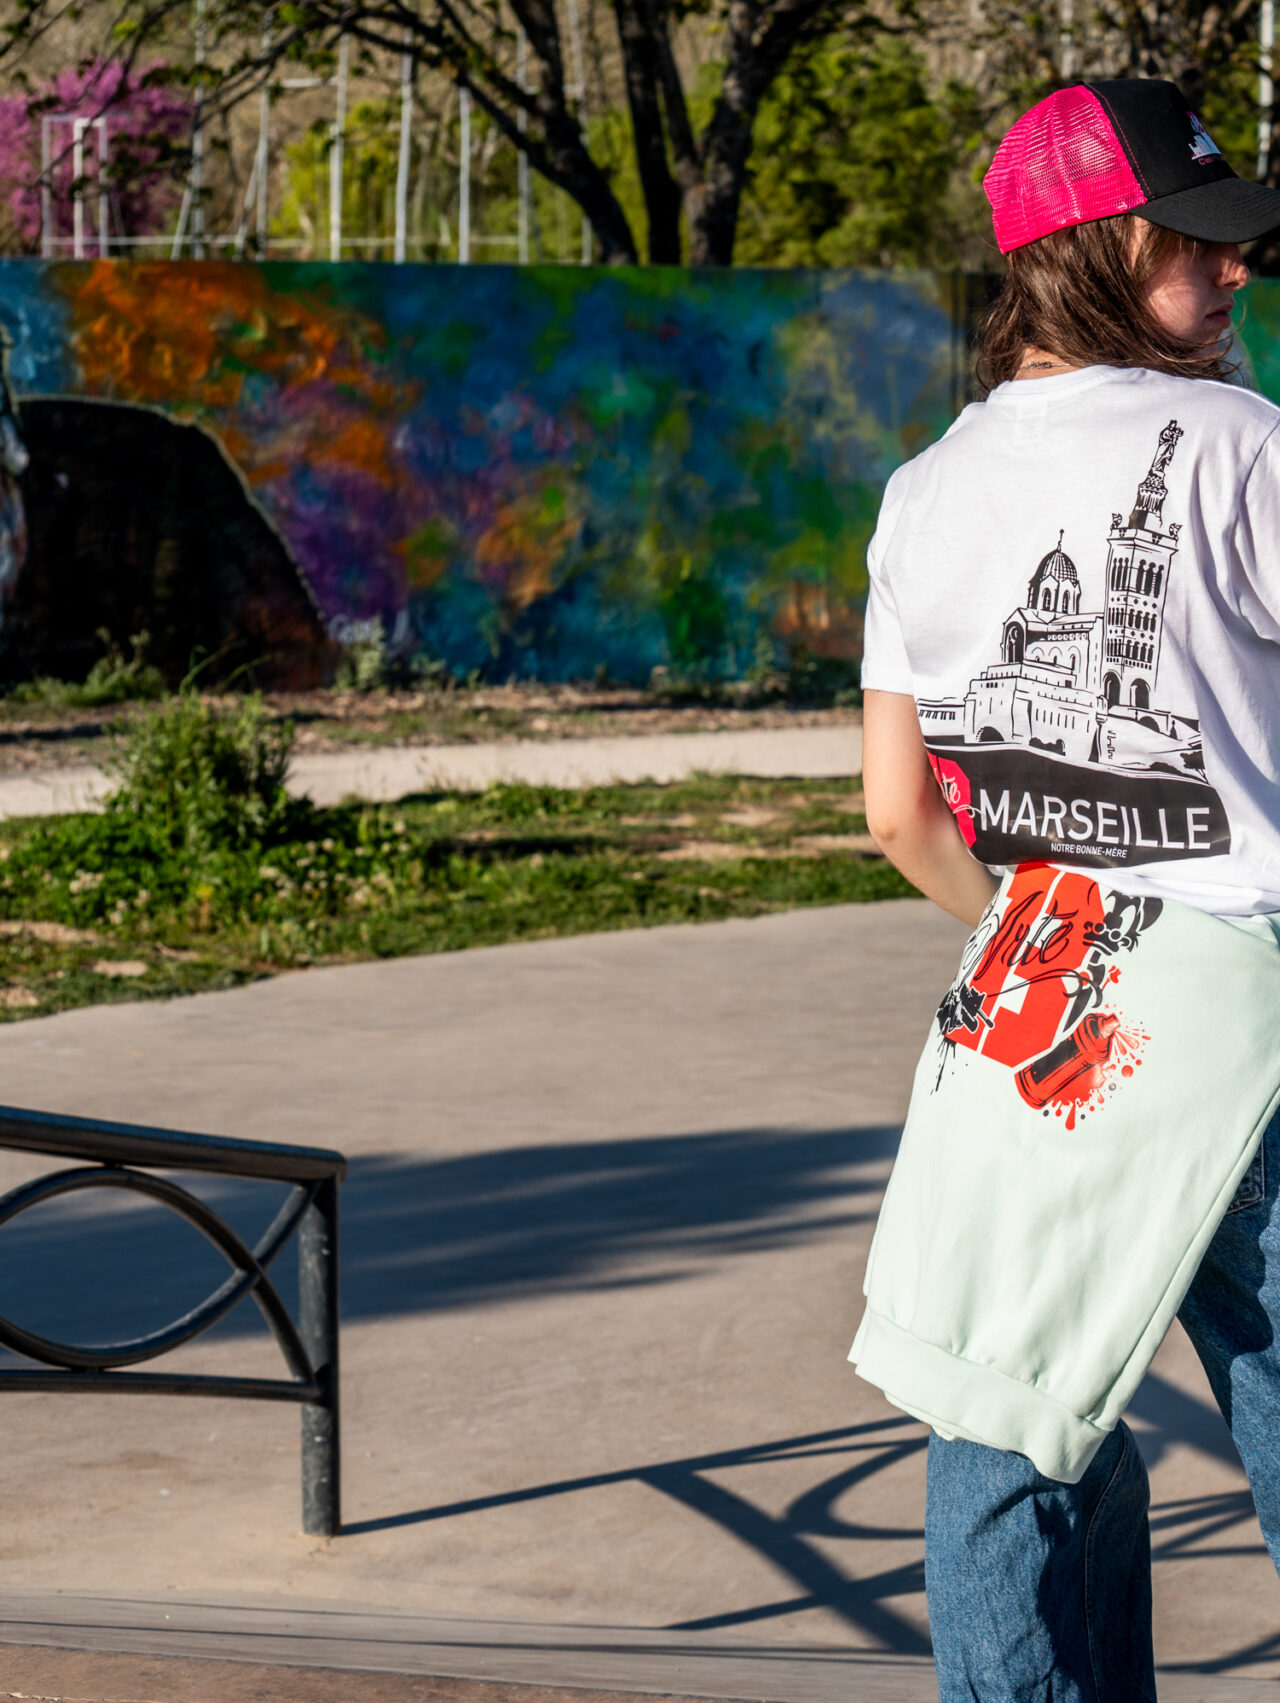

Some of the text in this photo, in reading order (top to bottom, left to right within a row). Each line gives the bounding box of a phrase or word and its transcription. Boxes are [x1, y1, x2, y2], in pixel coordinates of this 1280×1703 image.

[979, 789, 1211, 850] MARSEILLE
[1051, 843, 1128, 858] NOTRE BONNE-MÈRE
